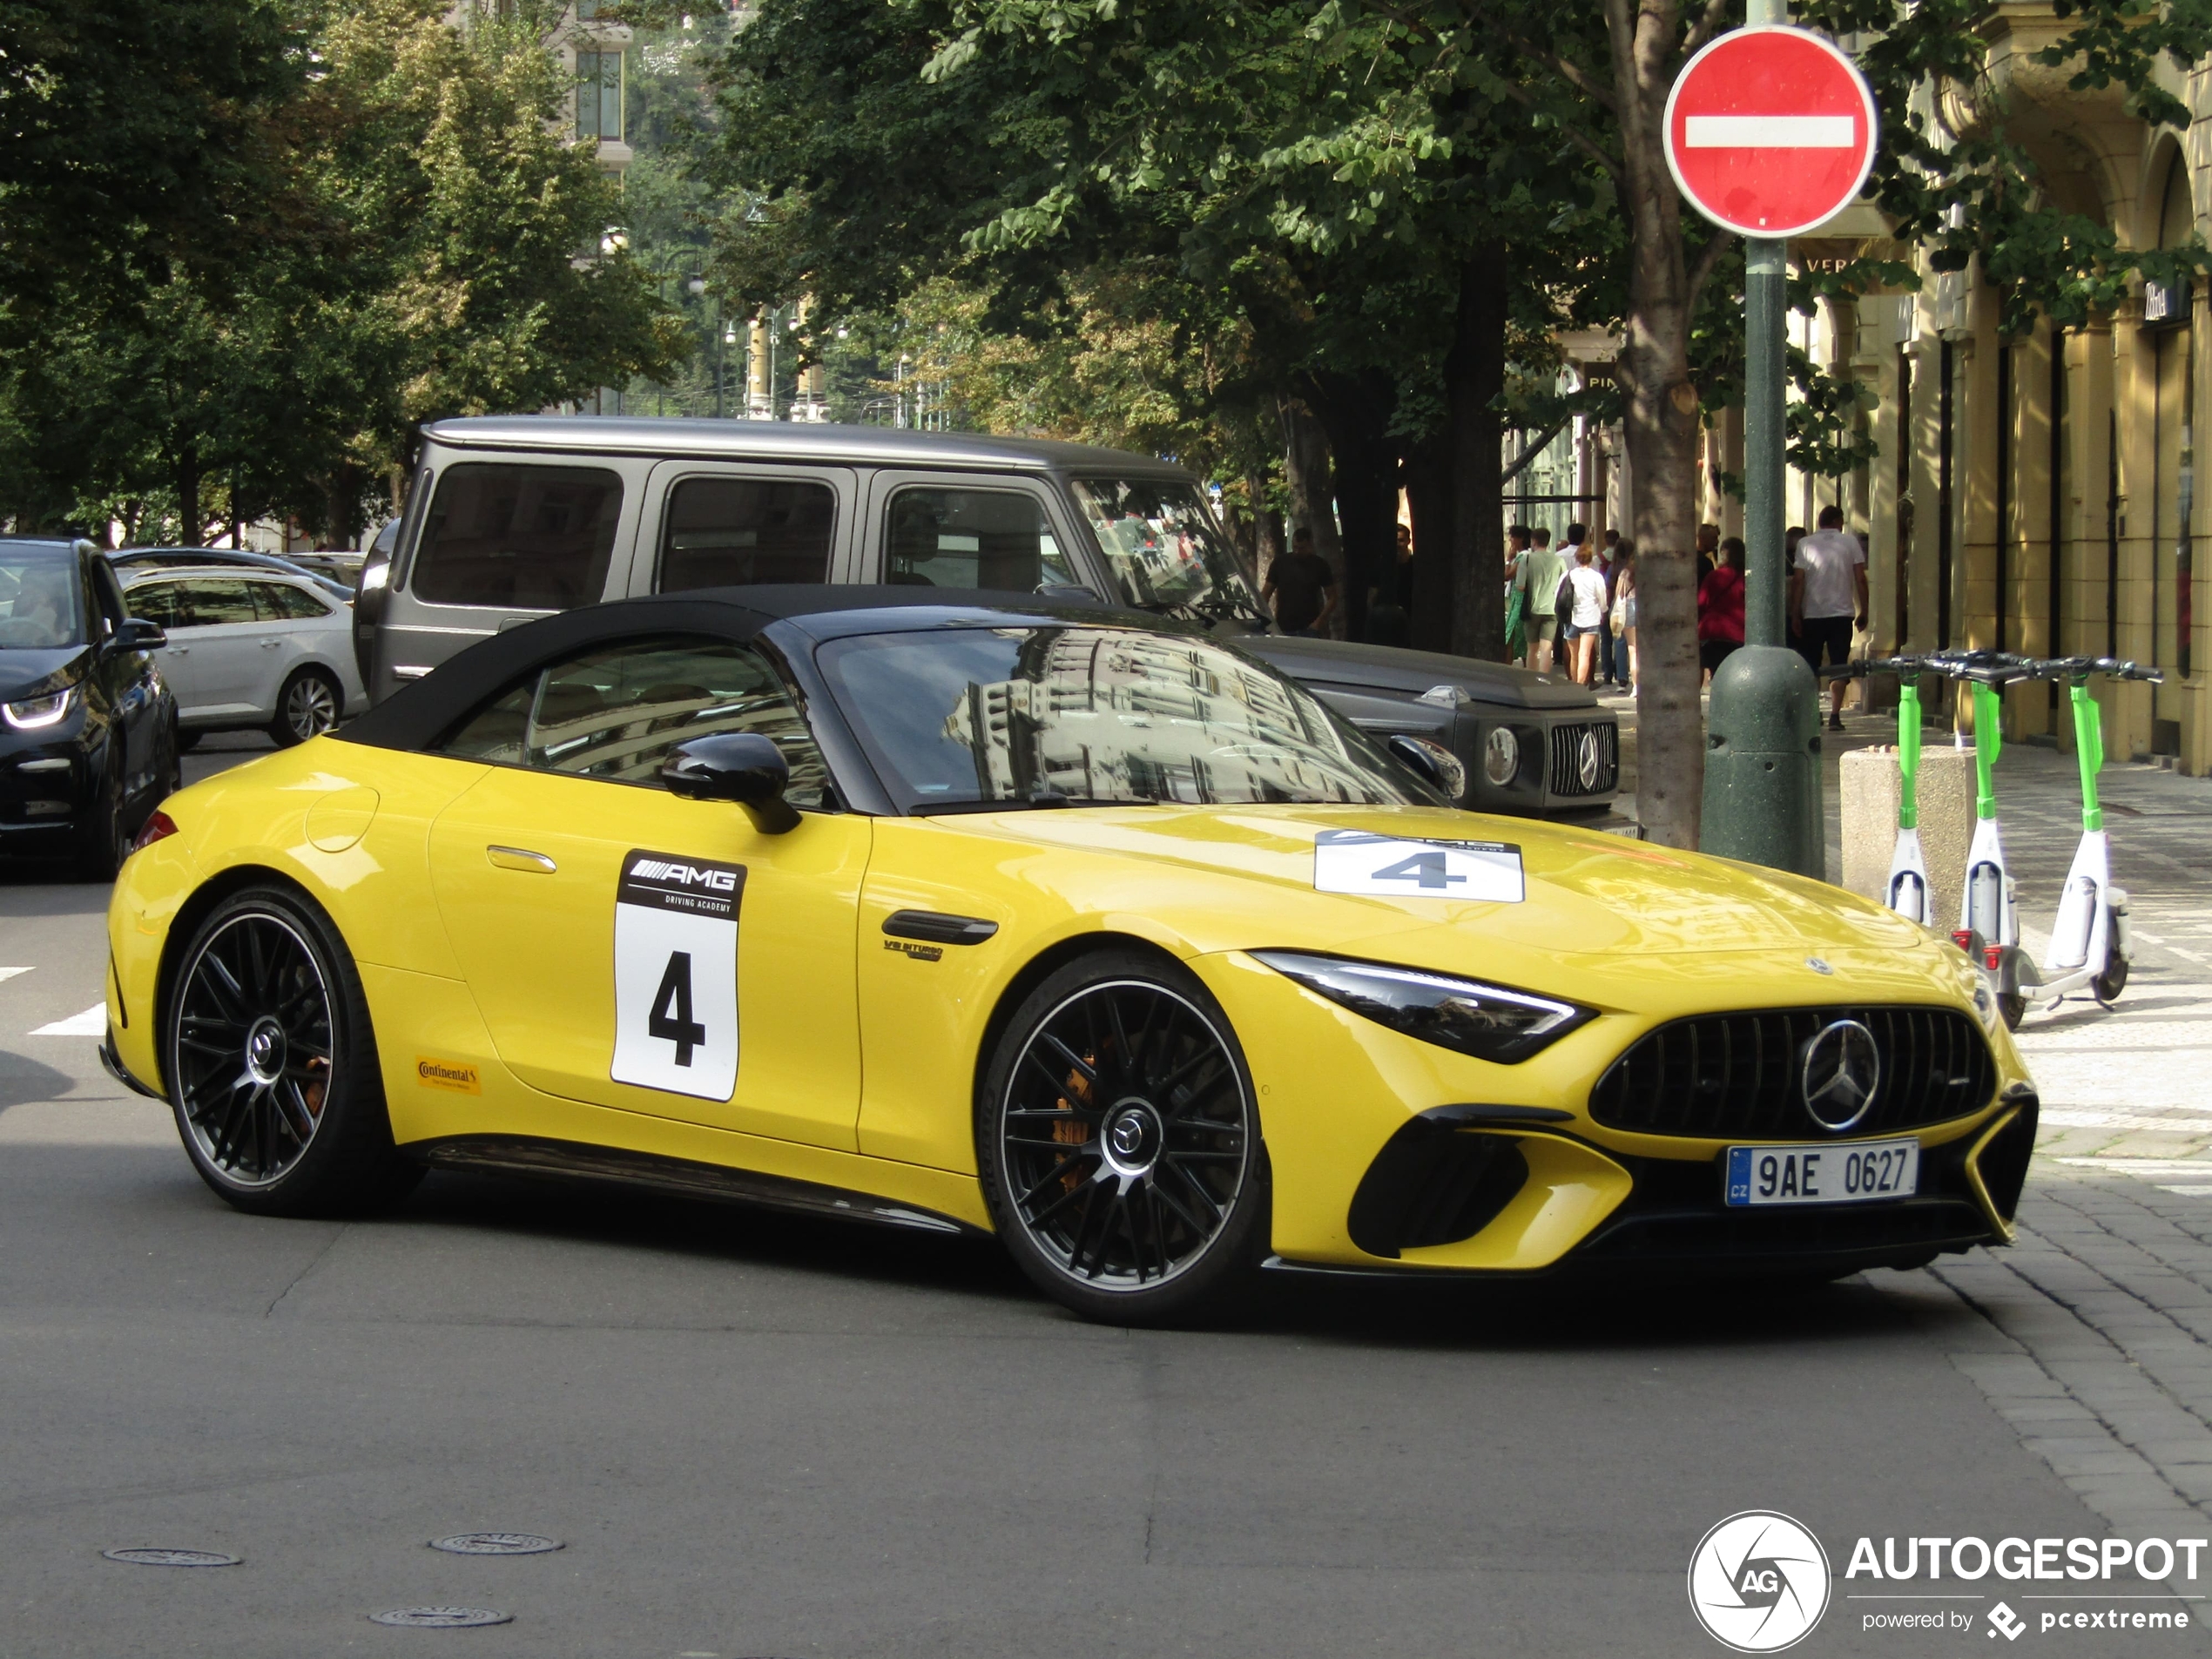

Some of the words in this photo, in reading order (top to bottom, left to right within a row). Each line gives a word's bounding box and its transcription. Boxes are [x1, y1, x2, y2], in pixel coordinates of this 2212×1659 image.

[663, 863, 738, 891] AMG
[1371, 852, 1467, 889] 4
[664, 894, 695, 907] DRIVING
[697, 900, 732, 914] ACADEMY
[649, 950, 706, 1068] 4
[418, 1061, 470, 1082] Continental
[1757, 1154, 1821, 1197] 9AE
[1844, 1148, 1907, 1194] 0627
[1730, 1184, 1748, 1198] CZ
